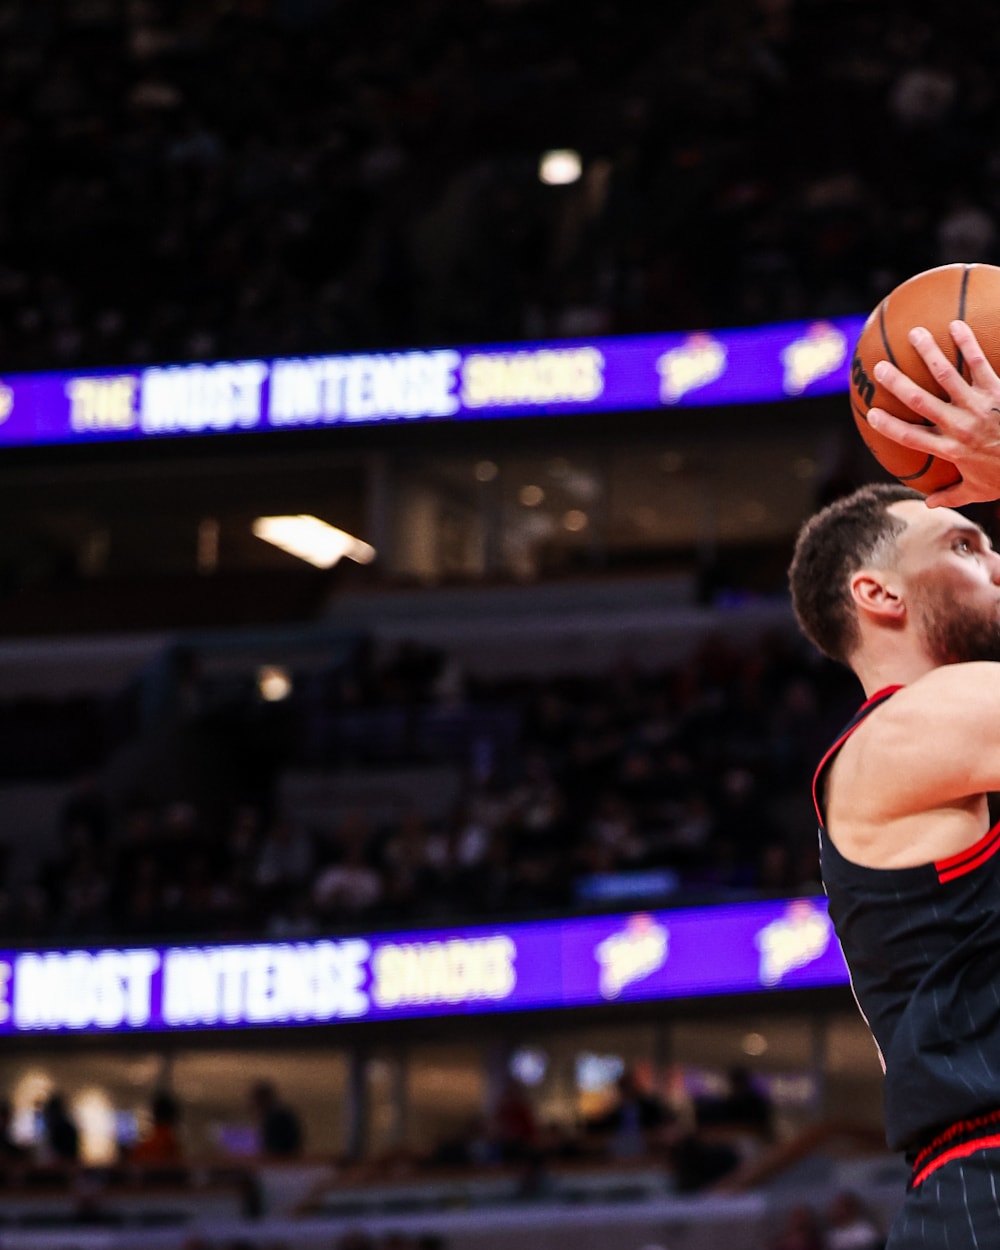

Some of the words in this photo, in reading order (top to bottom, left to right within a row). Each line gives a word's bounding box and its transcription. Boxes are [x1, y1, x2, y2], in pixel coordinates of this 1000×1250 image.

[140, 358, 268, 434] MOST
[268, 348, 461, 427] INTENSE
[14, 951, 159, 1030] MOST
[161, 938, 370, 1026] INTENSE
